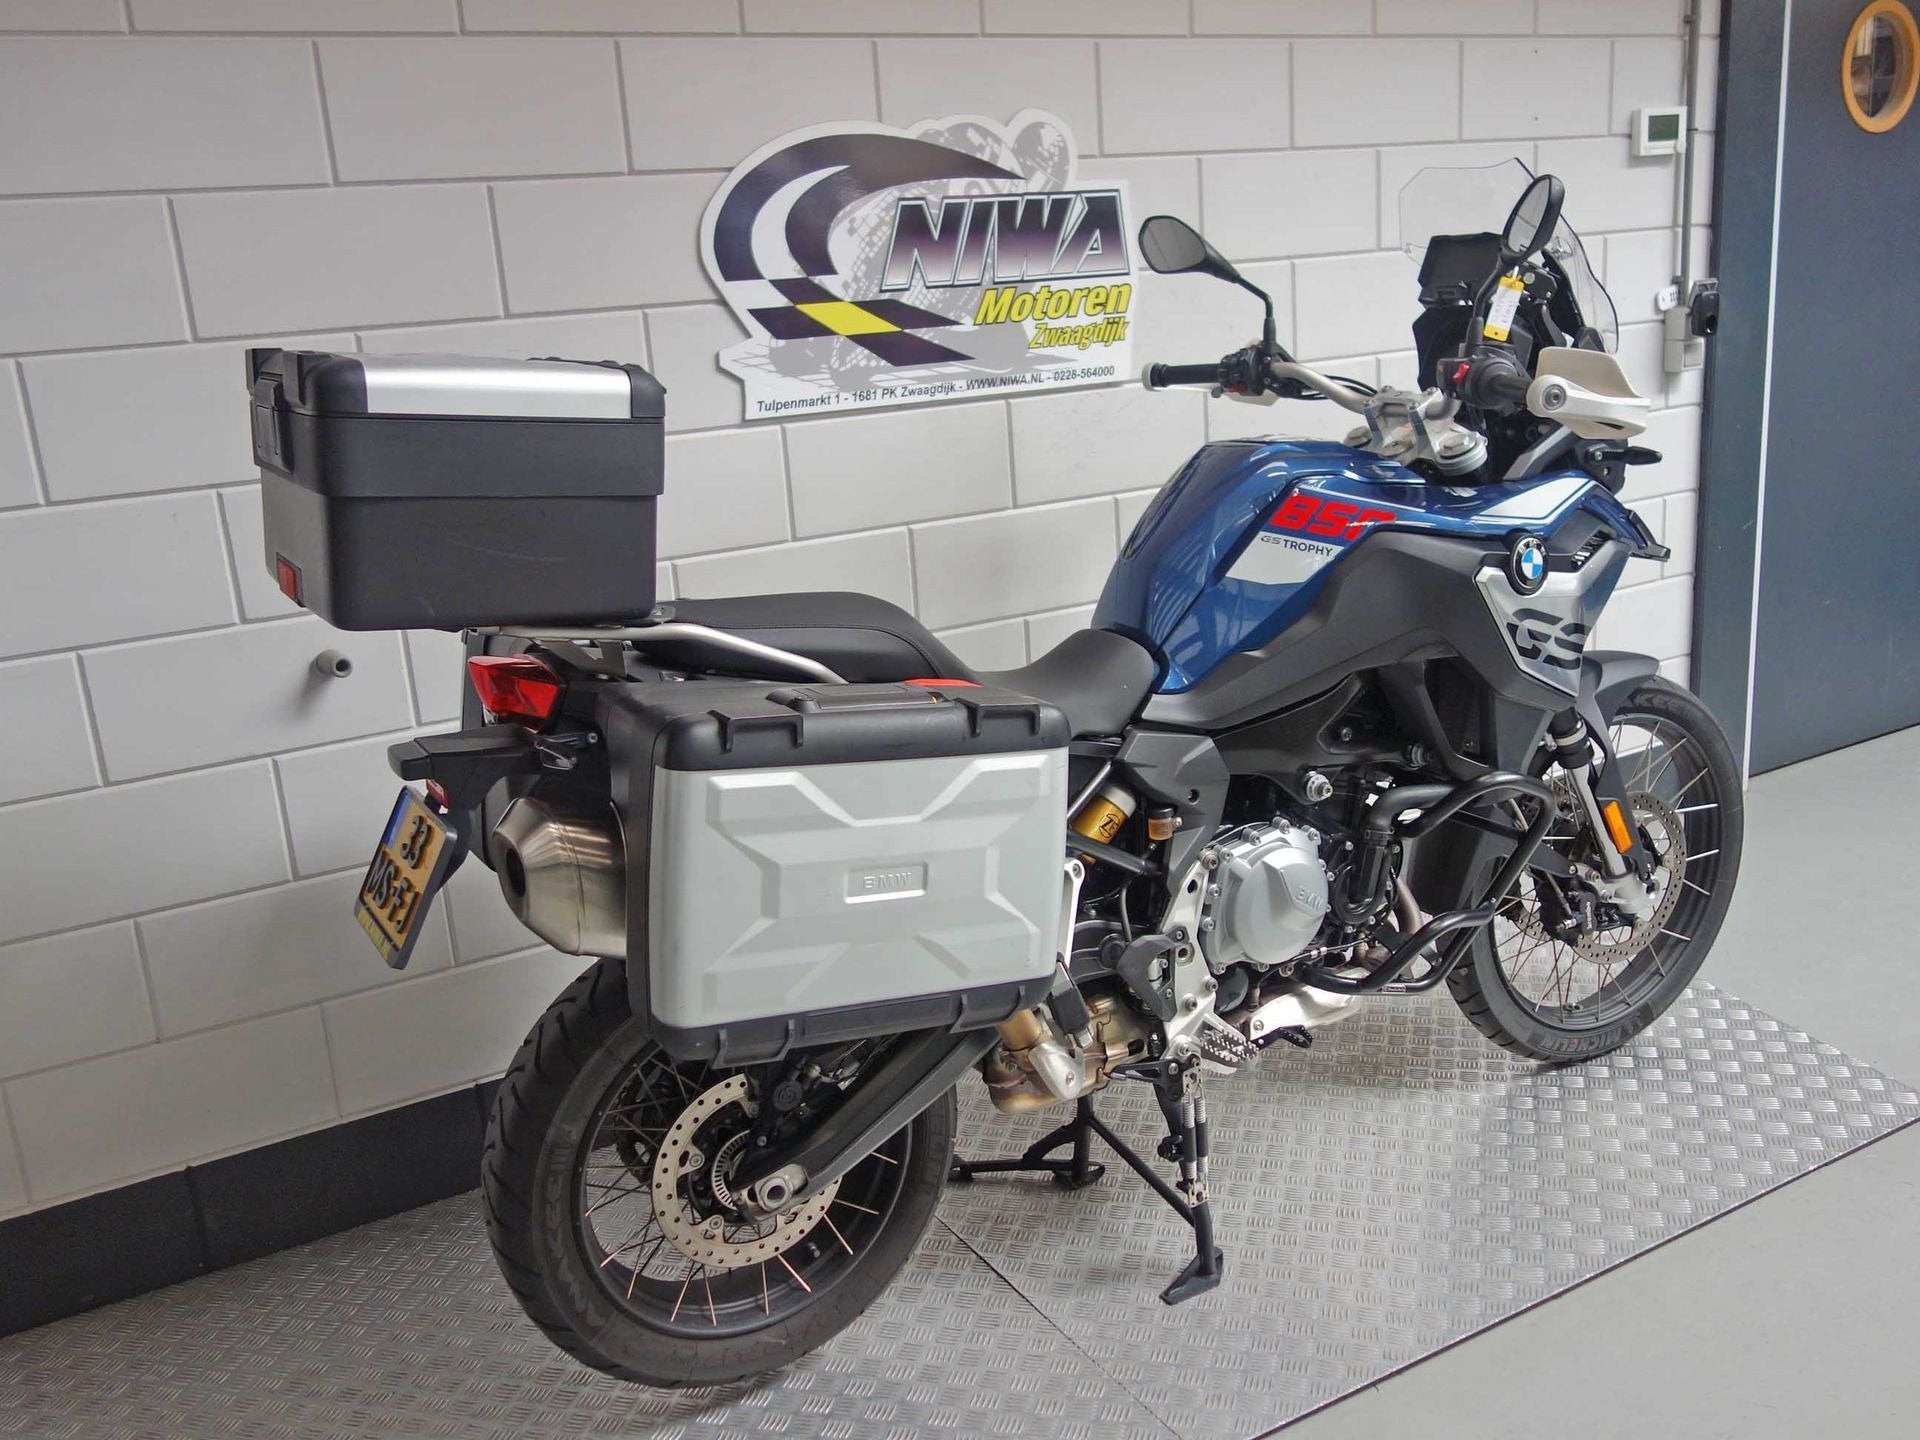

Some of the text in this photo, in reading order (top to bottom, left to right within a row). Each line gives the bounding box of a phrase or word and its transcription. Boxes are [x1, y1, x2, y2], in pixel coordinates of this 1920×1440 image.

[879, 189, 1131, 293] NIWA
[973, 283, 1132, 326] Motoren
[1028, 316, 1130, 351] Zwaagdijk
[757, 394, 832, 413] Tulpenmarkt
[834, 393, 840, 405] 1
[852, 388, 877, 403] 1681
[881, 387, 898, 400] PK
[901, 378, 957, 397] Zwaagdijk
[966, 372, 1045, 391] WWW.NIWA.NL
[1053, 365, 1115, 382] 0228-564000
[1282, 538, 1334, 557] TROPHY
